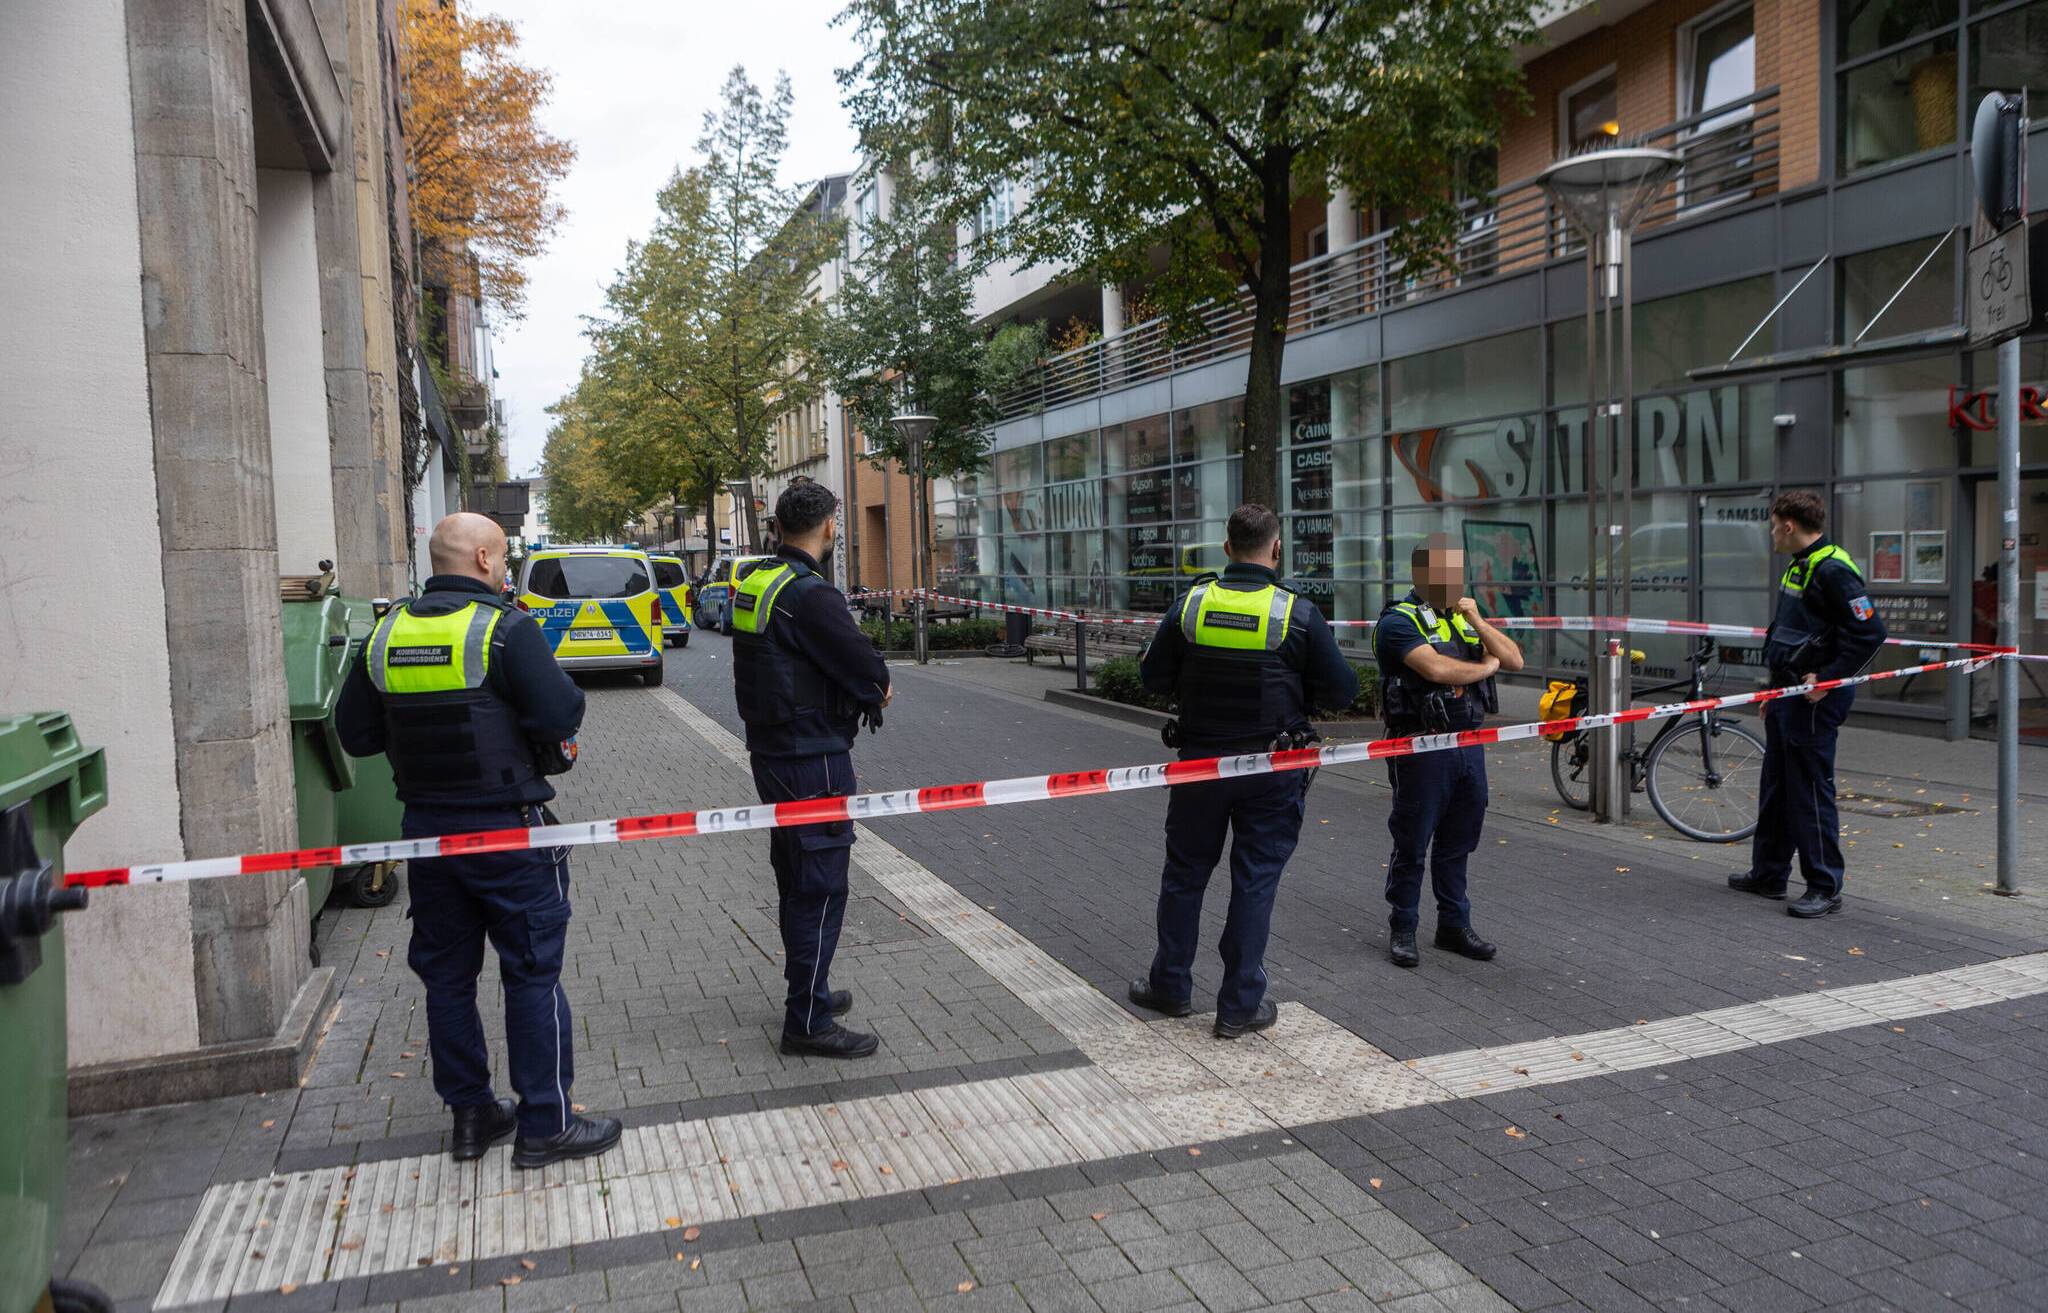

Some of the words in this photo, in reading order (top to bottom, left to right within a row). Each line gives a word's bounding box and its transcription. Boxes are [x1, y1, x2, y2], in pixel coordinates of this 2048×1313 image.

[1948, 384, 2048, 432] KUR
[1495, 385, 1740, 498] SATURN
[529, 608, 576, 618] POLIZEI
